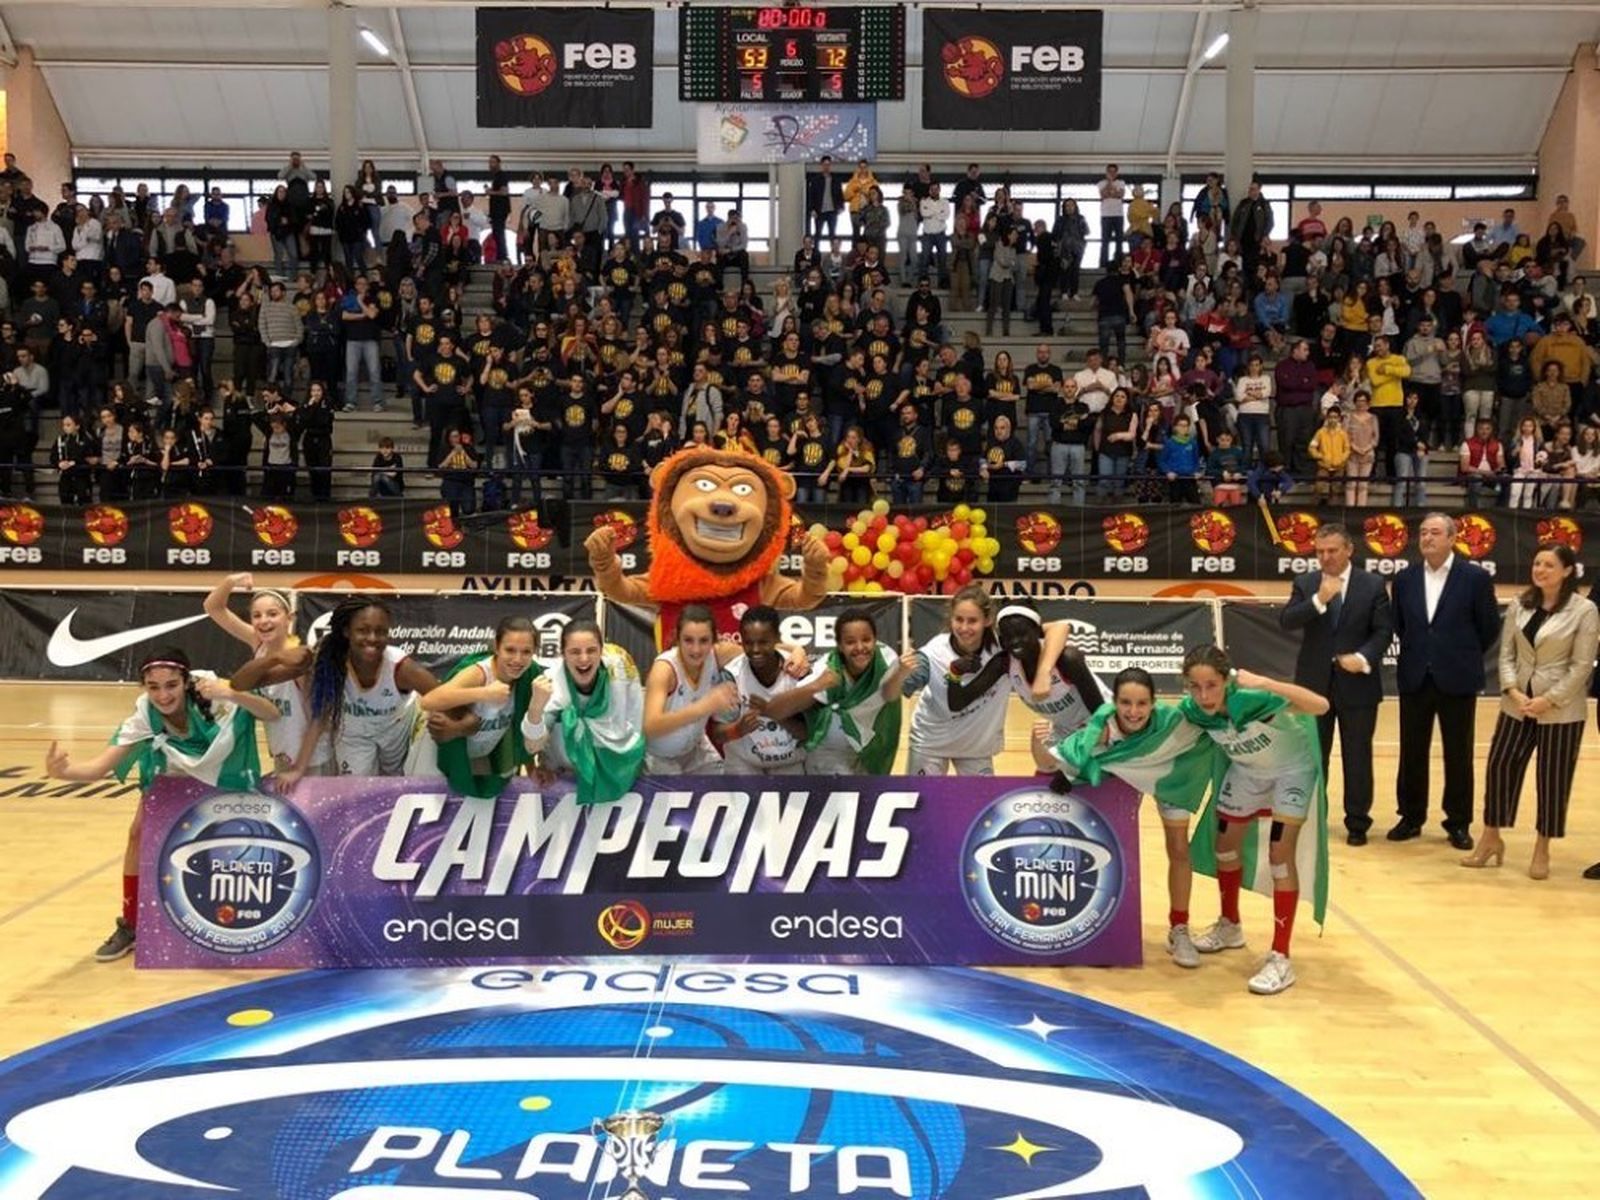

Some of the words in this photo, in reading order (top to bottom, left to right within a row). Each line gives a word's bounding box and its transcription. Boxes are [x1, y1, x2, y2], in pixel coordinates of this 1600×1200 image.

[736, 33, 768, 42] LOCAL
[786, 41, 797, 57] 6
[744, 48, 767, 67] 53
[752, 74, 762, 89] 5
[832, 74, 842, 89] 5
[462, 576, 597, 590] AYUNTA
[989, 581, 1096, 596] ANDO
[1100, 631, 1168, 642] Ayuntamiento
[1171, 631, 1184, 640] de
[400, 641, 415, 654] de
[1101, 643, 1125, 654] San
[1126, 642, 1184, 654] Fernando
[1109, 660, 1123, 668] DE
[213, 803, 272, 814] endesa
[1012, 801, 1070, 814] endesa
[372, 791, 919, 895] CAMPEONAS
[211, 859, 273, 874] PLANETA
[1015, 857, 1075, 872] PLANETA
[210, 873, 272, 903] MINI
[1015, 872, 1075, 901] MINI
[181, 912, 202, 934] SAN
[205, 931, 268, 946] FERNANDO
[383, 912, 519, 942] endesa
[653, 919, 694, 929] MUJER
[770, 909, 903, 940] endesa
[989, 911, 1010, 931] SAN
[1013, 927, 1074, 943] FERNANDO
[471, 964, 860, 995] endesa
[348, 1126, 913, 1197] PLANETA
